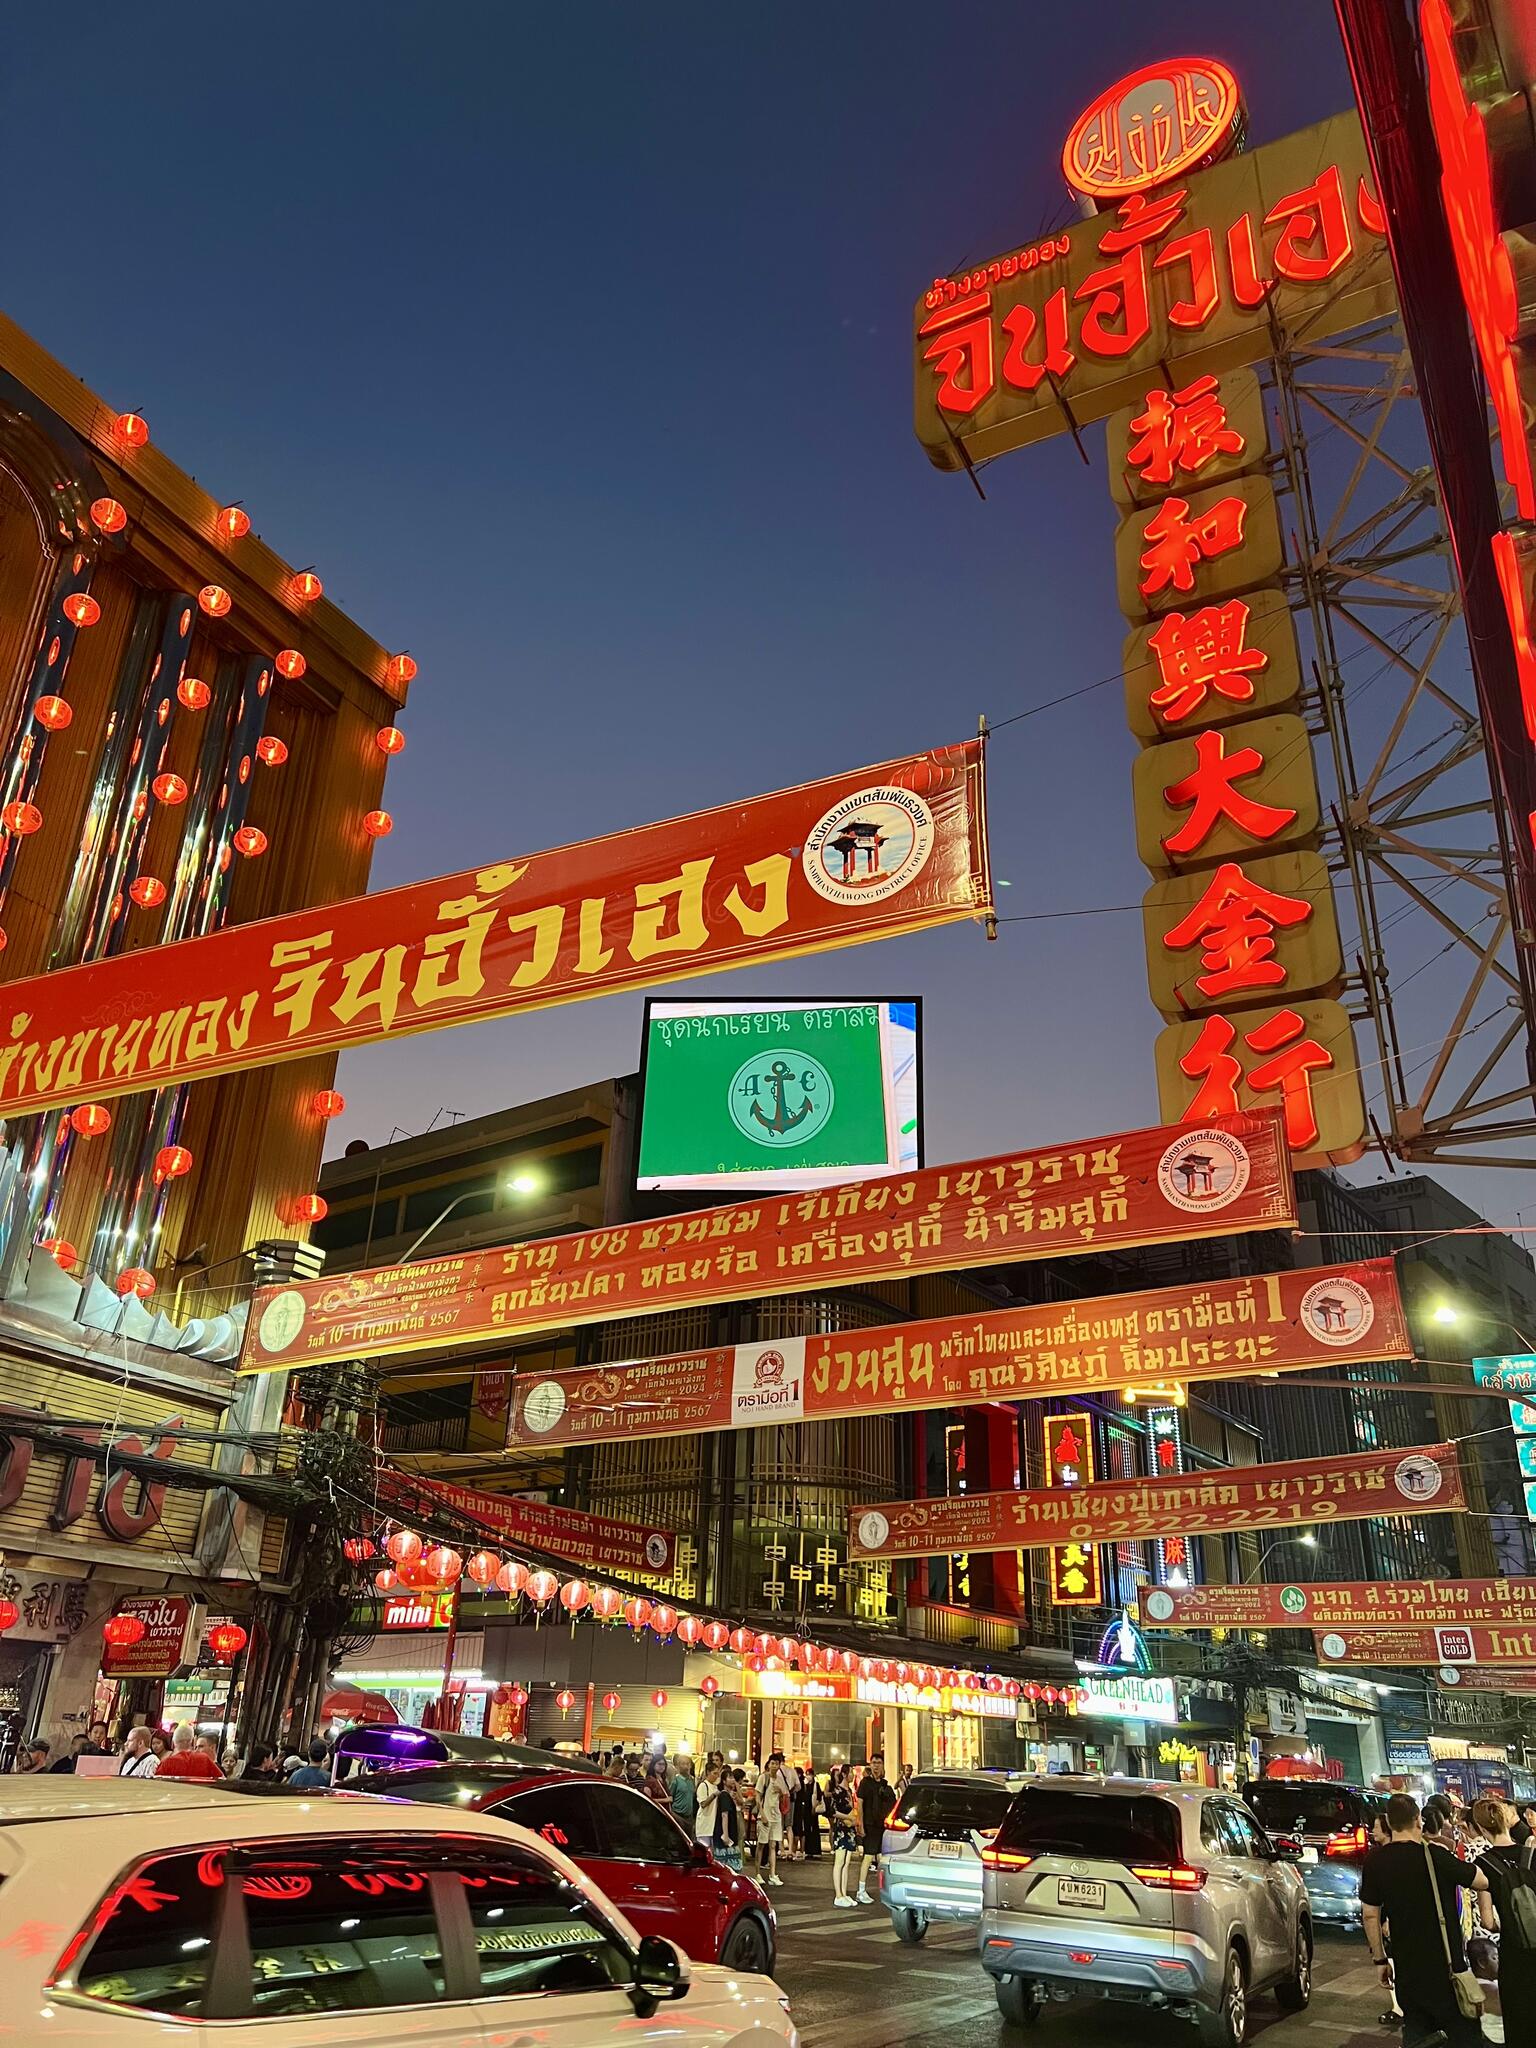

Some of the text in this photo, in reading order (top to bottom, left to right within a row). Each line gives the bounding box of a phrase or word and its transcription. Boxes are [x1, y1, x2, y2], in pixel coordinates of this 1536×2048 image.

[924, 234, 1071, 309] ห้างขายทอง
[808, 788, 932, 852] สำนักงานเขตสัมพันธวงศ์
[807, 837, 928, 901] SAMPHANTHAWONG DISTRICT OFFICE
[502, 1243, 559, 1274] ร้าน
[572, 1229, 631, 1262] 198
[638, 1208, 761, 1250] ชวนชิม
[937, 1143, 1122, 1199] เยาวราช
[1210, 1189, 1236, 1208] DISTRICT
[490, 1269, 626, 1323] ลูกชิ้นปลา
[776, 1202, 944, 1266] เครื่องสุกี้
[962, 1175, 1131, 1242] น้ำจิ้มสุกี้
[1146, 1280, 1257, 1333] ตรามือที่
[1263, 1275, 1287, 1323] 1
[367, 1309, 427, 1345] กุมภาพันธ์
[430, 1309, 461, 1327] 2567
[811, 1336, 934, 1399] ง่วนสูน
[943, 1376, 962, 1392] โดย
[1119, 1335, 1279, 1372] ลิ้มประนะ
[678, 1384, 706, 1395] 2024
[737, 1384, 790, 1408] ตรามือที่
[570, 1415, 588, 1433] วันที่
[590, 1412, 625, 1430] 10-11
[684, 1404, 712, 1419] 2567
[755, 1404, 774, 1412] HAND
[1255, 1465, 1386, 1502] เยาวราช
[972, 1516, 991, 1525] 2024
[1070, 1500, 1338, 1538] 0-2222-2219
[599, 1523, 644, 1545] เยาวราช
[908, 1533, 934, 1548] 10-11
[976, 1531, 997, 1543] 2567
[598, 1543, 644, 1566] เยาวราช
[387, 1600, 432, 1624] mini
[1192, 1611, 1213, 1621] 10-11
[1464, 1607, 1493, 1620] และ
[149, 1623, 184, 1638] เยาวราช
[1362, 1651, 1381, 1660] 10-11
[1442, 1635, 1469, 1655] Inter GOLD
[1080, 1884, 1102, 1896] 6231
